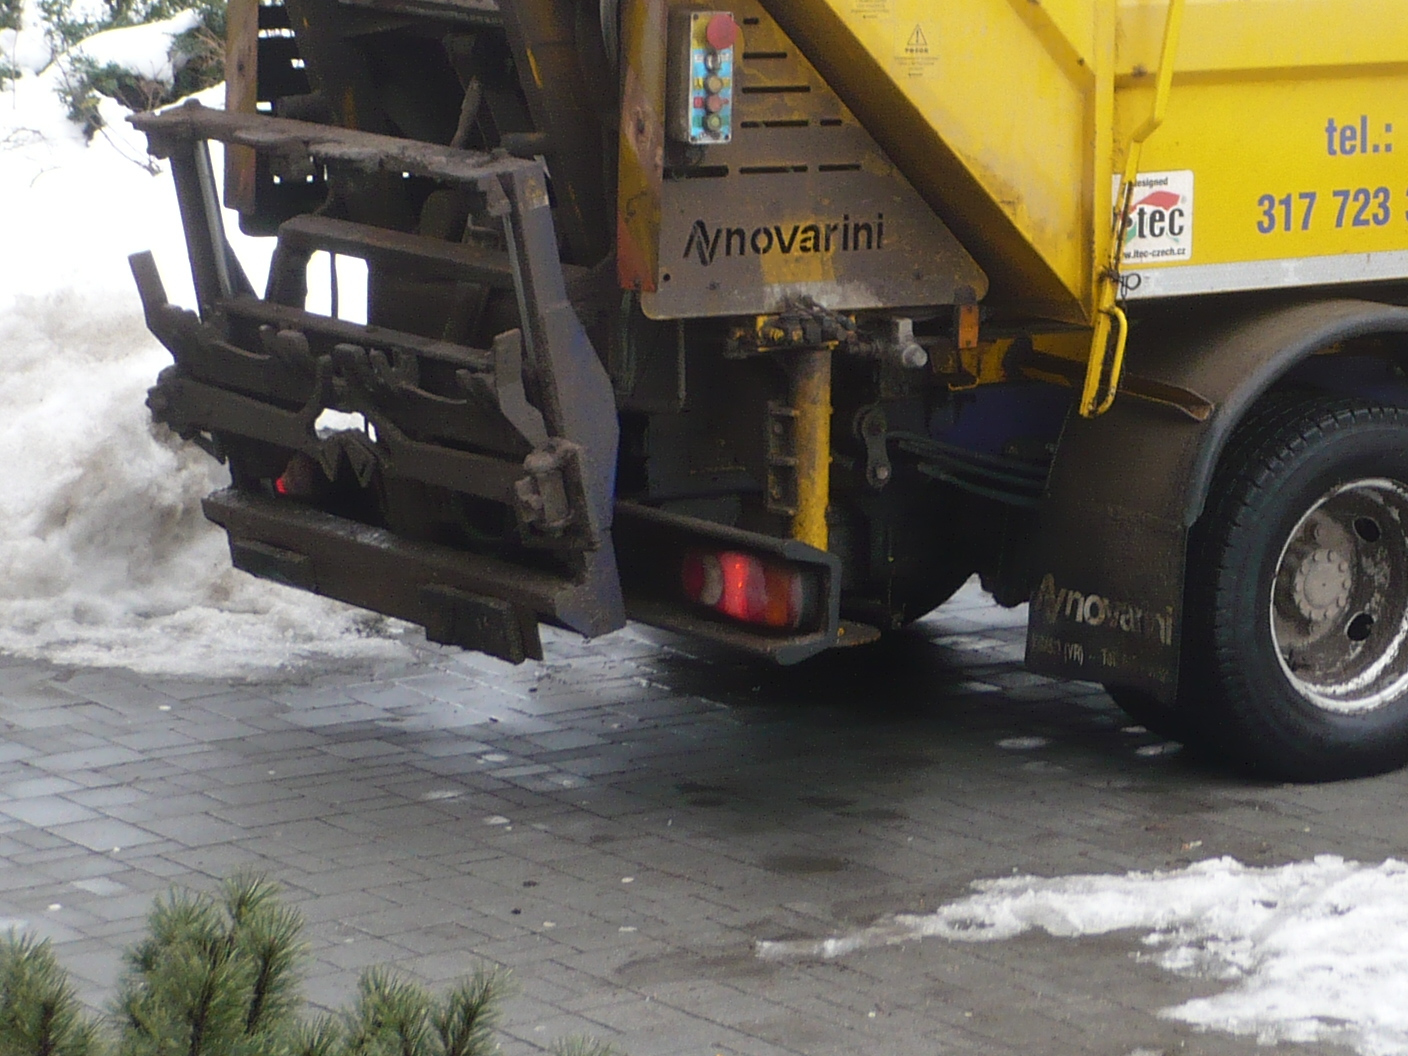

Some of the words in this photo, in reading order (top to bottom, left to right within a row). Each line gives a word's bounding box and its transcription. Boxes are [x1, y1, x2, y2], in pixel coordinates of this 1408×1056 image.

[1325, 115, 1393, 156] tel.:
[1256, 192, 1317, 234] 317
[1332, 187, 1391, 228] 723
